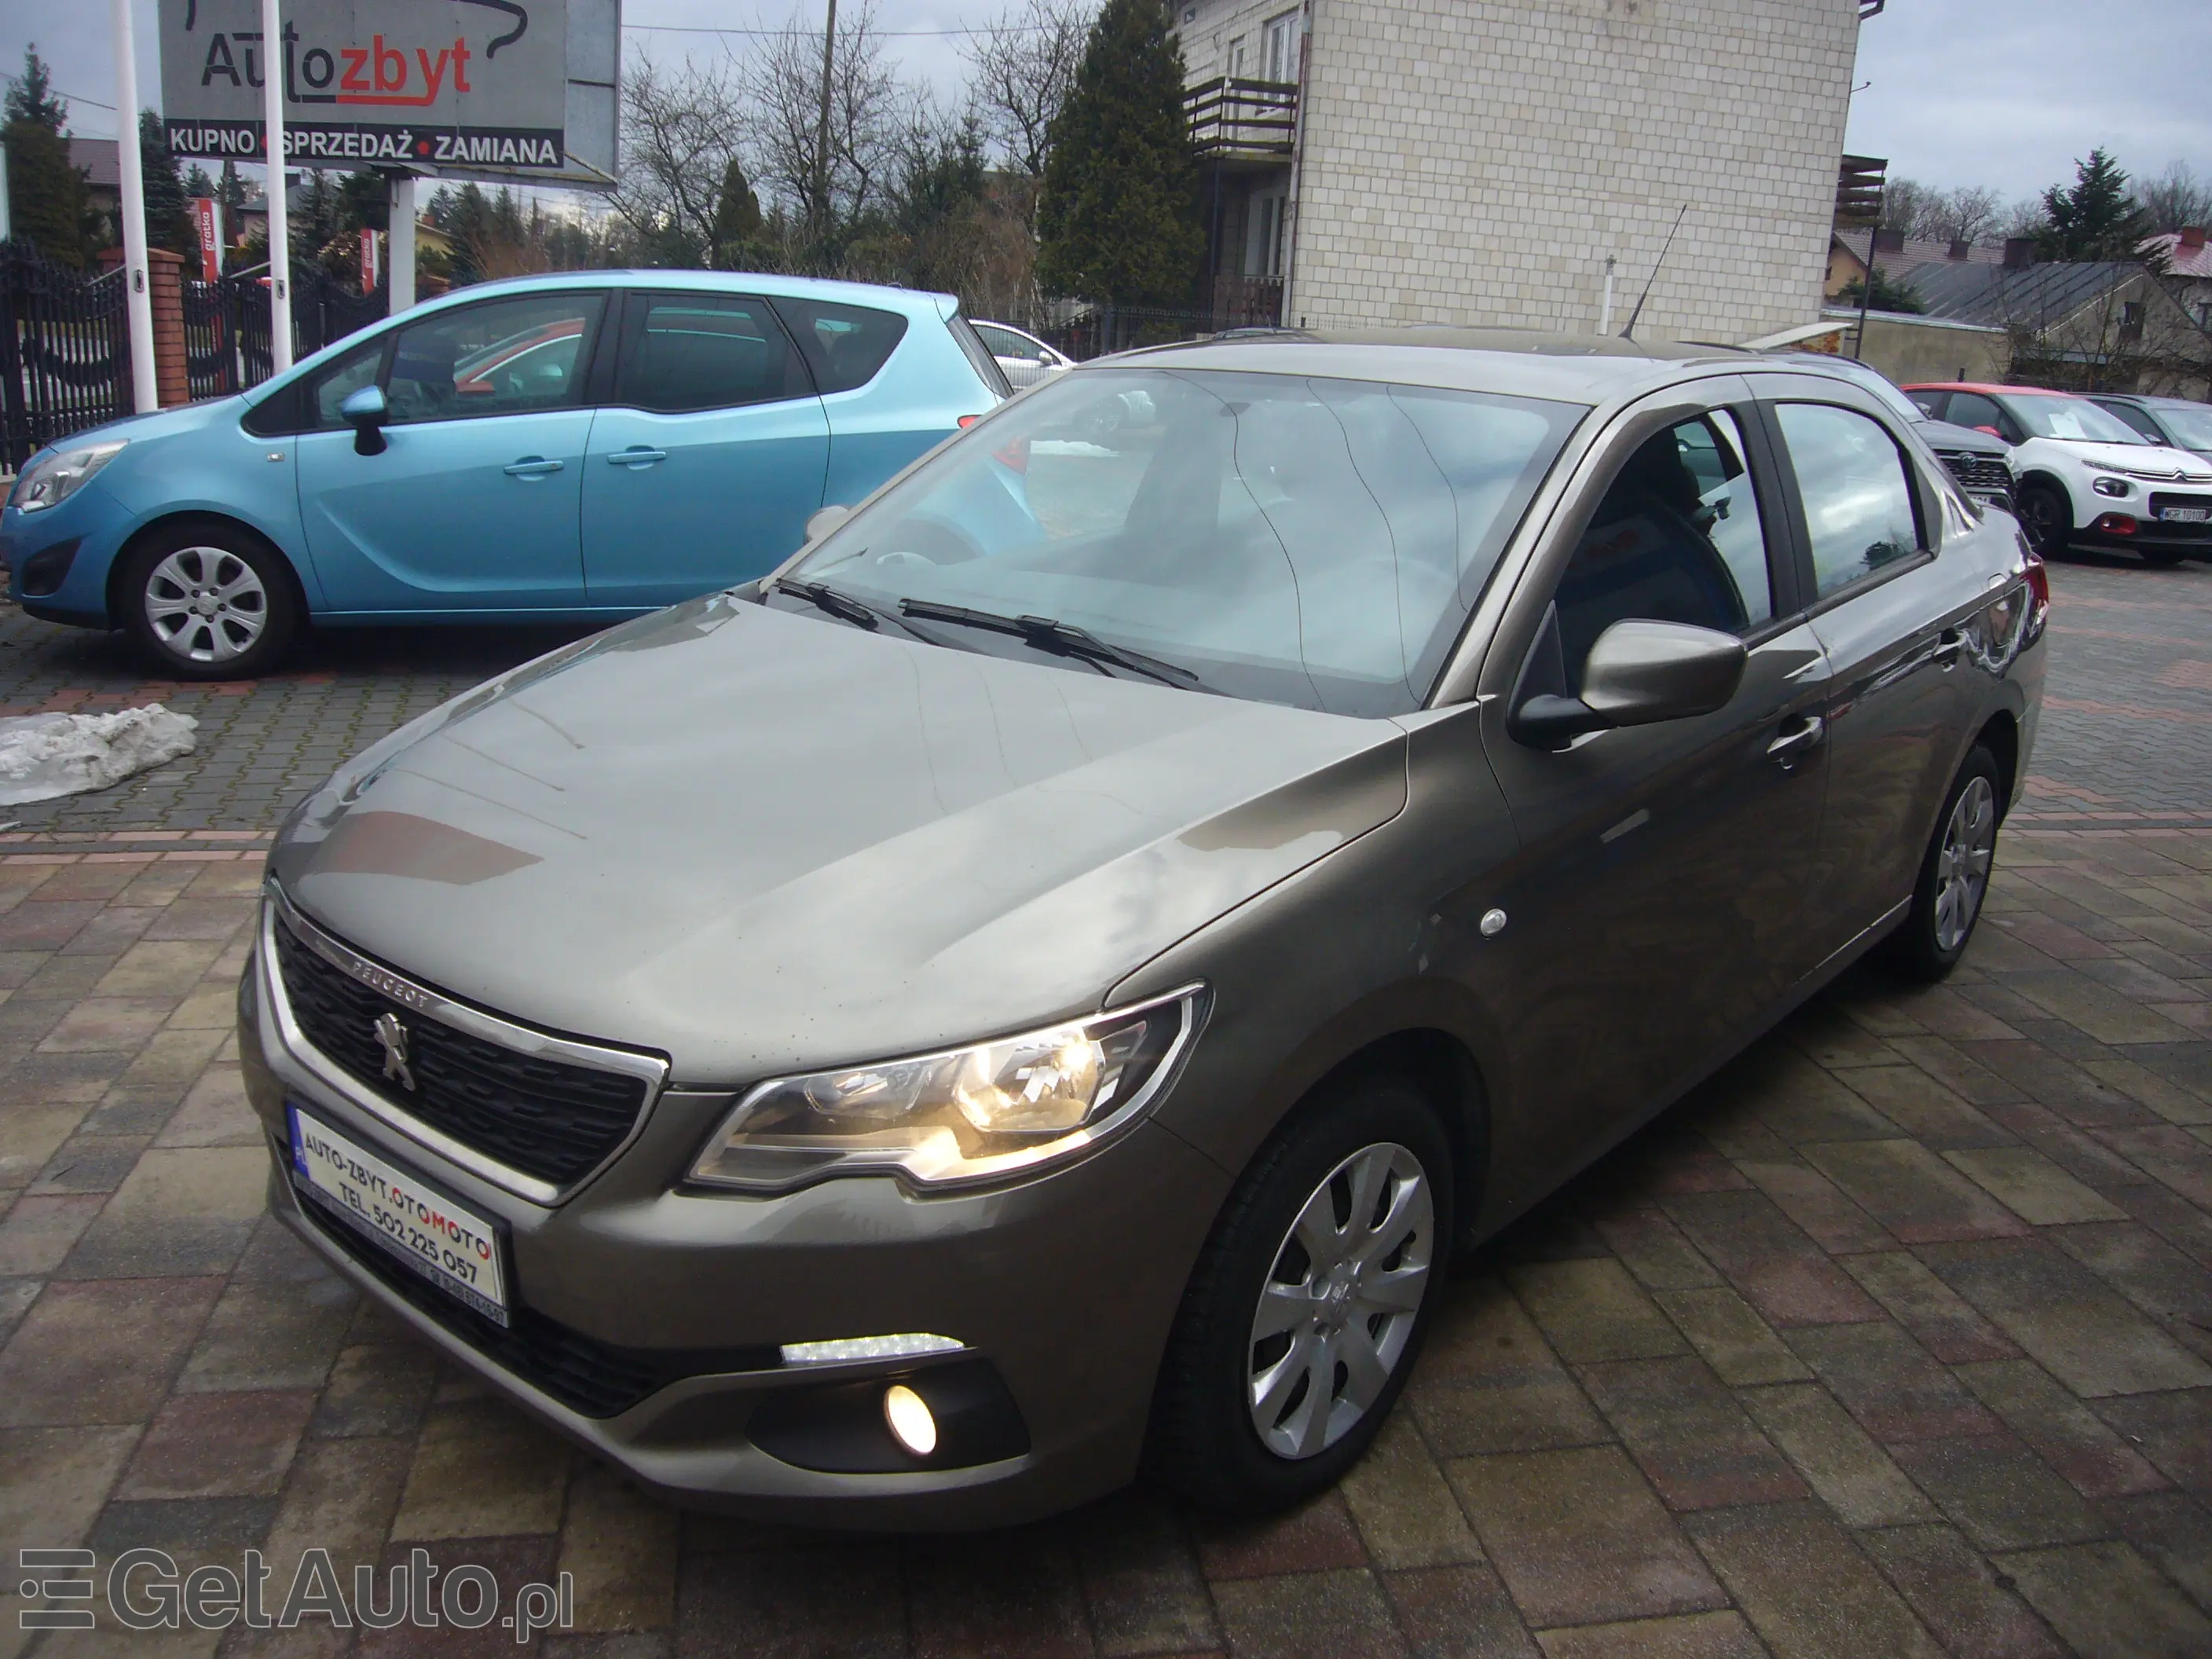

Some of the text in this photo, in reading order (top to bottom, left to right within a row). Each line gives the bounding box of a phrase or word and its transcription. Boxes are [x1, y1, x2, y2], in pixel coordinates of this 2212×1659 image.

[170, 128, 558, 164] KUPNO SPRZEDAŻ ZAMIANA
[203, 211, 216, 251] gratka
[352, 961, 429, 1008] PEUGEOT
[339, 1181, 478, 1284] TEL. 502 225 057
